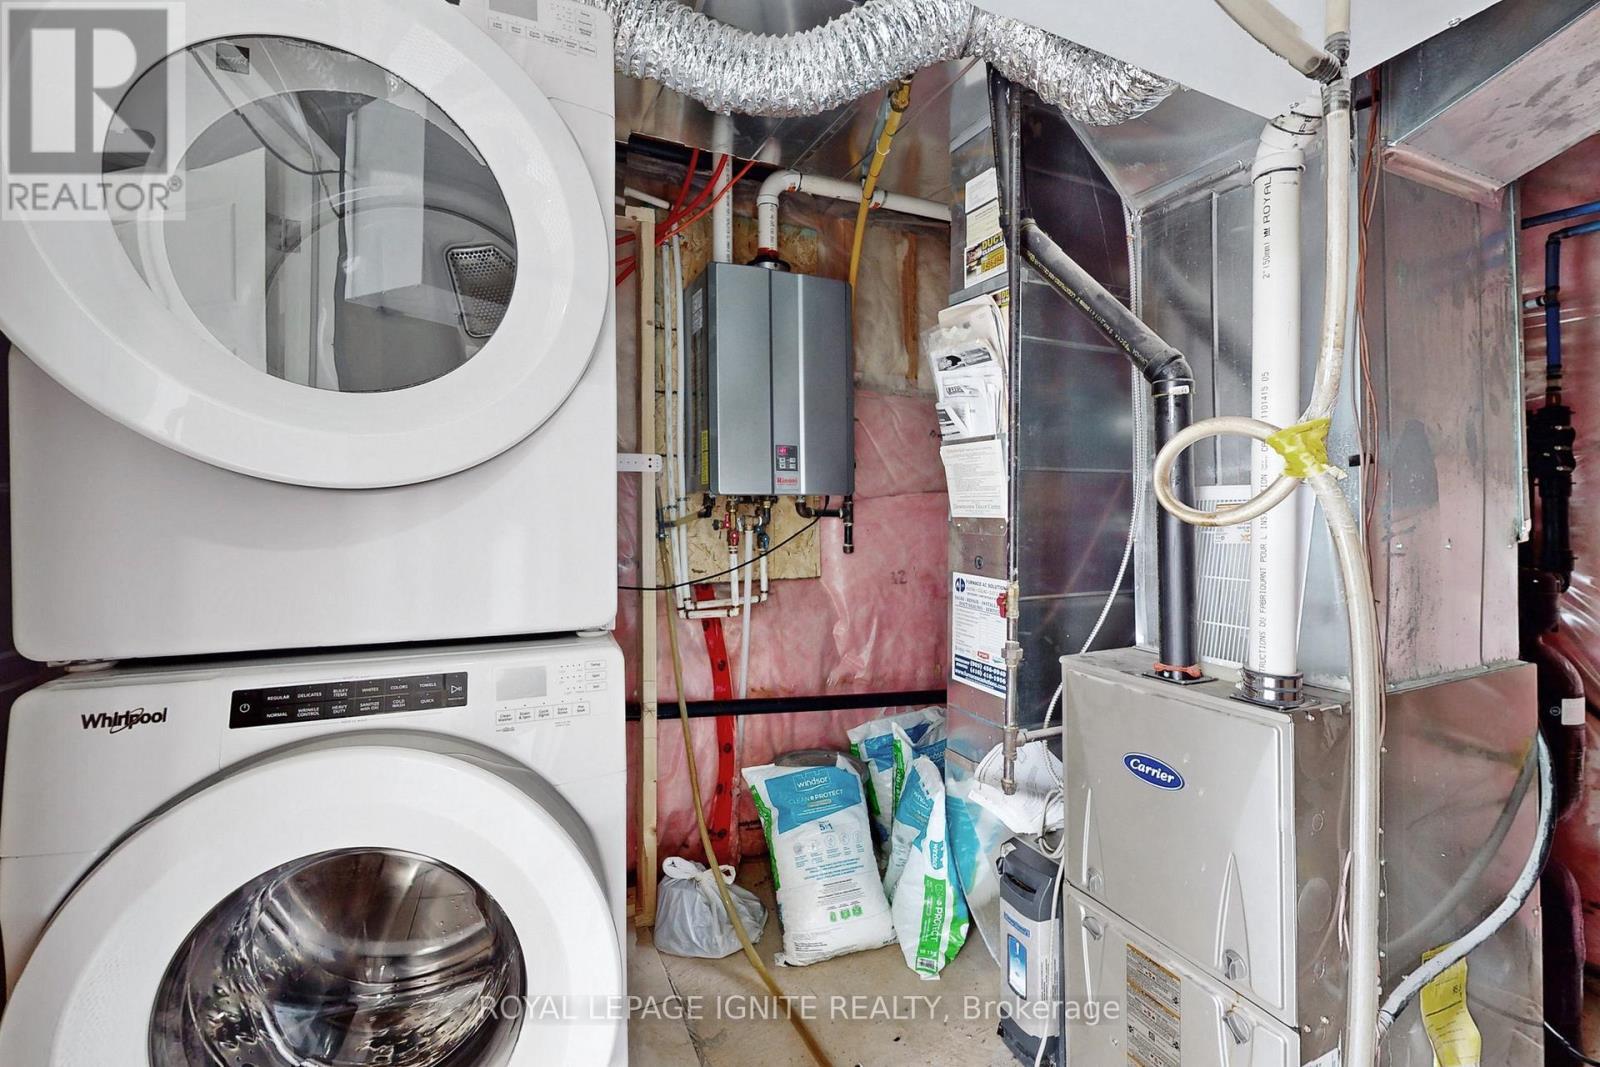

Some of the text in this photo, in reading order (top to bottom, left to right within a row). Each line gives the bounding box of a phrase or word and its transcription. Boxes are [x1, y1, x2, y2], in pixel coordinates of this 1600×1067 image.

[1262, 176, 1272, 224] ROYAL
[81, 707, 168, 734] Whirlpool
[796, 776, 830, 789] windsor
[1129, 758, 1175, 784] Carrier
[813, 788, 844, 801] PROTECT
[930, 906, 943, 943] PROTECT
